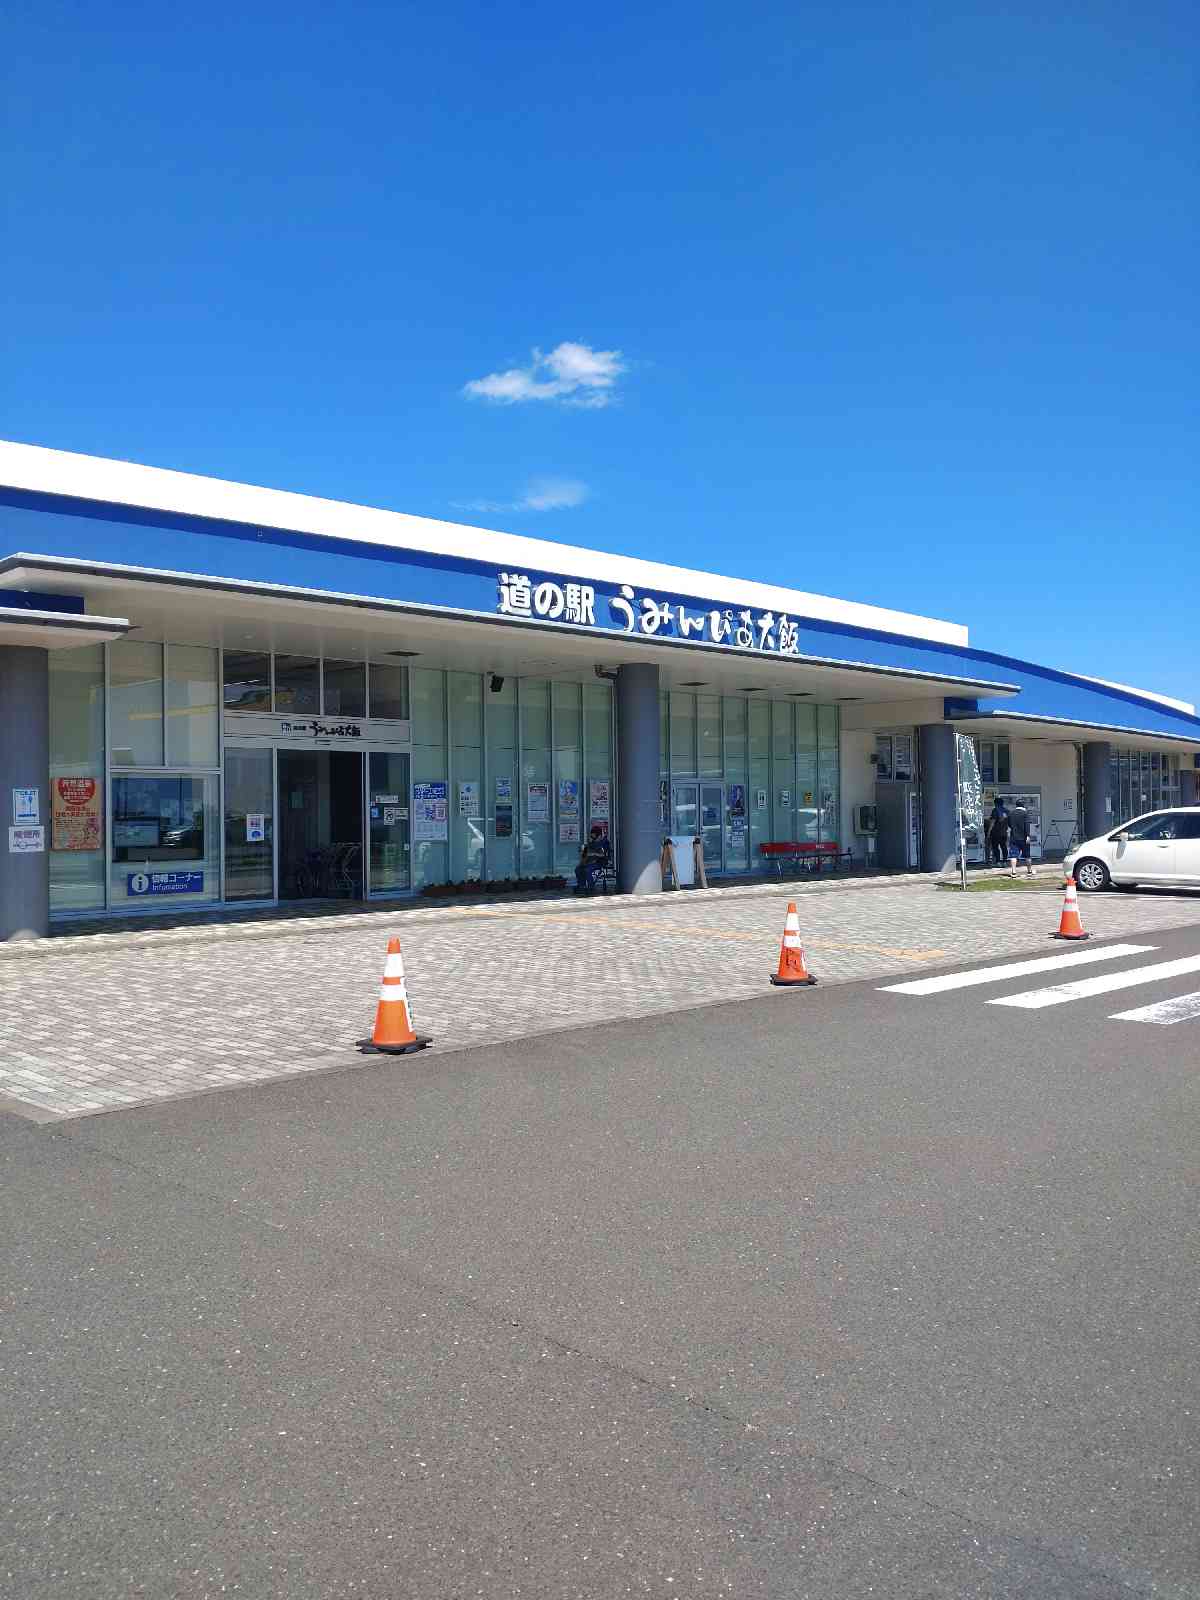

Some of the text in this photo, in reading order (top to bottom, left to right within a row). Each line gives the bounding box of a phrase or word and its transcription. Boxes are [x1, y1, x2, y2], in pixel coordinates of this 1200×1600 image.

[498, 572, 800, 654] 道の駅 うみんぴあ大飯
